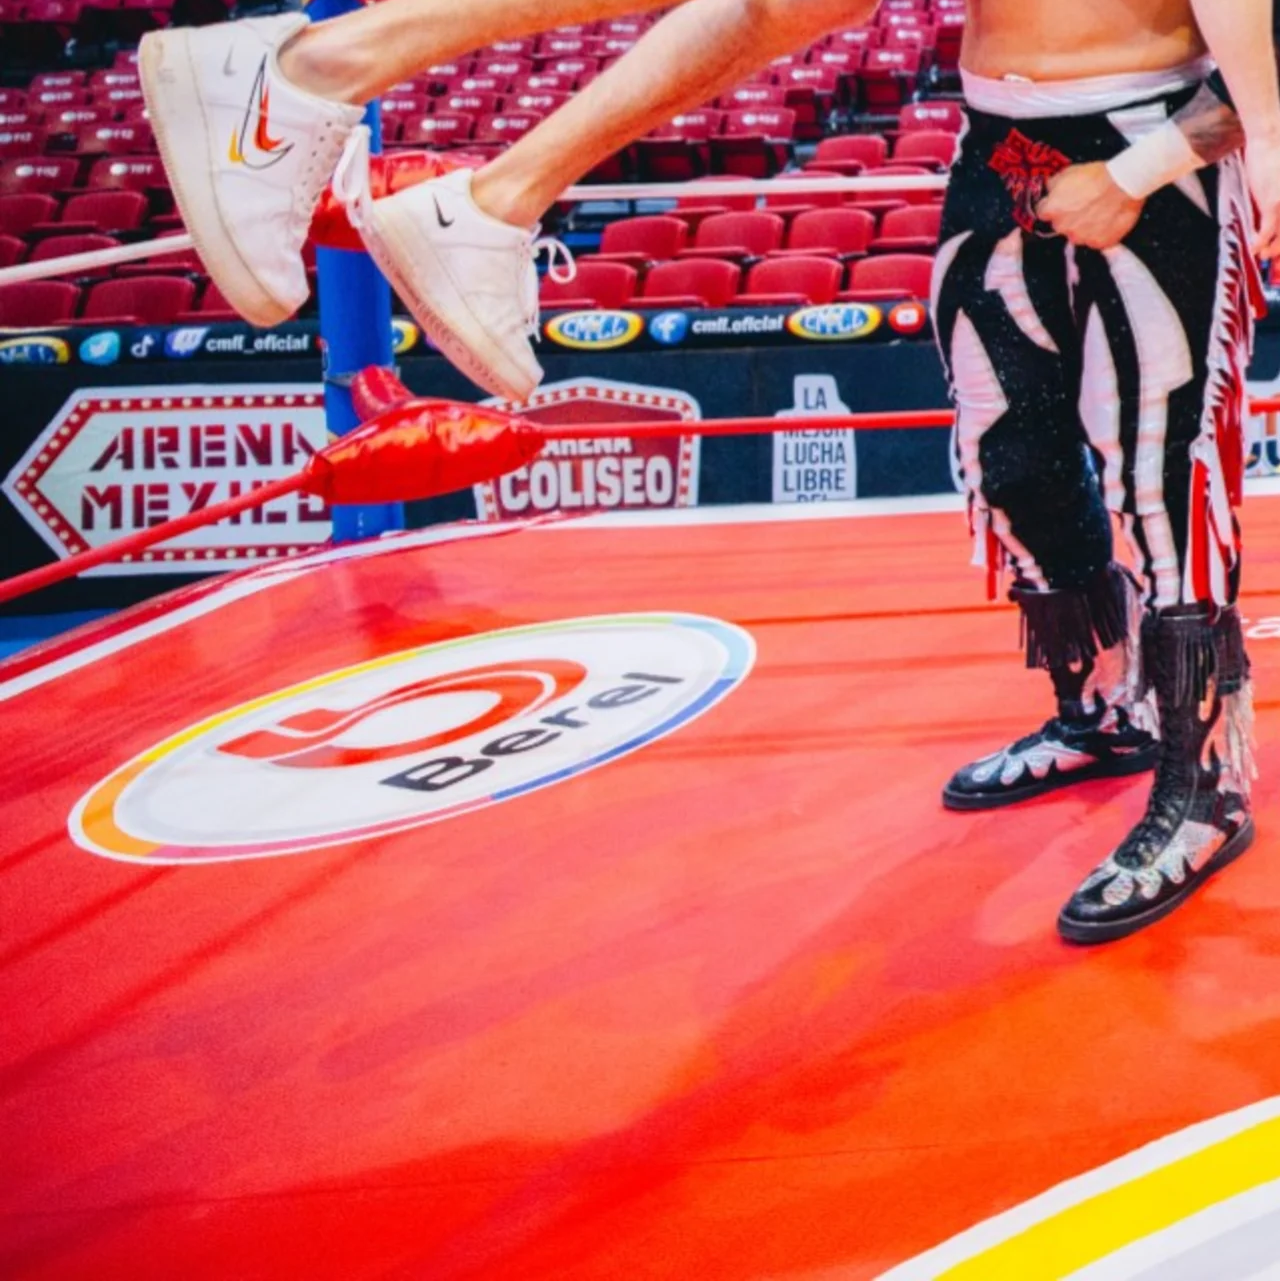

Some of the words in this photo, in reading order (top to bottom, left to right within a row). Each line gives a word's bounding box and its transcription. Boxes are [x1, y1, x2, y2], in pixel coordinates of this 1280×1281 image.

[560, 318, 625, 342] CMLL
[690, 313, 785, 335] cmll.oficial
[801, 306, 865, 334] CMLL
[205, 331, 310, 355] cmll_oficial
[803, 386, 828, 410] LA
[88, 422, 318, 472] ARENA
[782, 442, 847, 465] LUCHA
[500, 454, 674, 511] COLISEO
[782, 468, 847, 492] LIBRE
[378, 670, 686, 794] Berel
